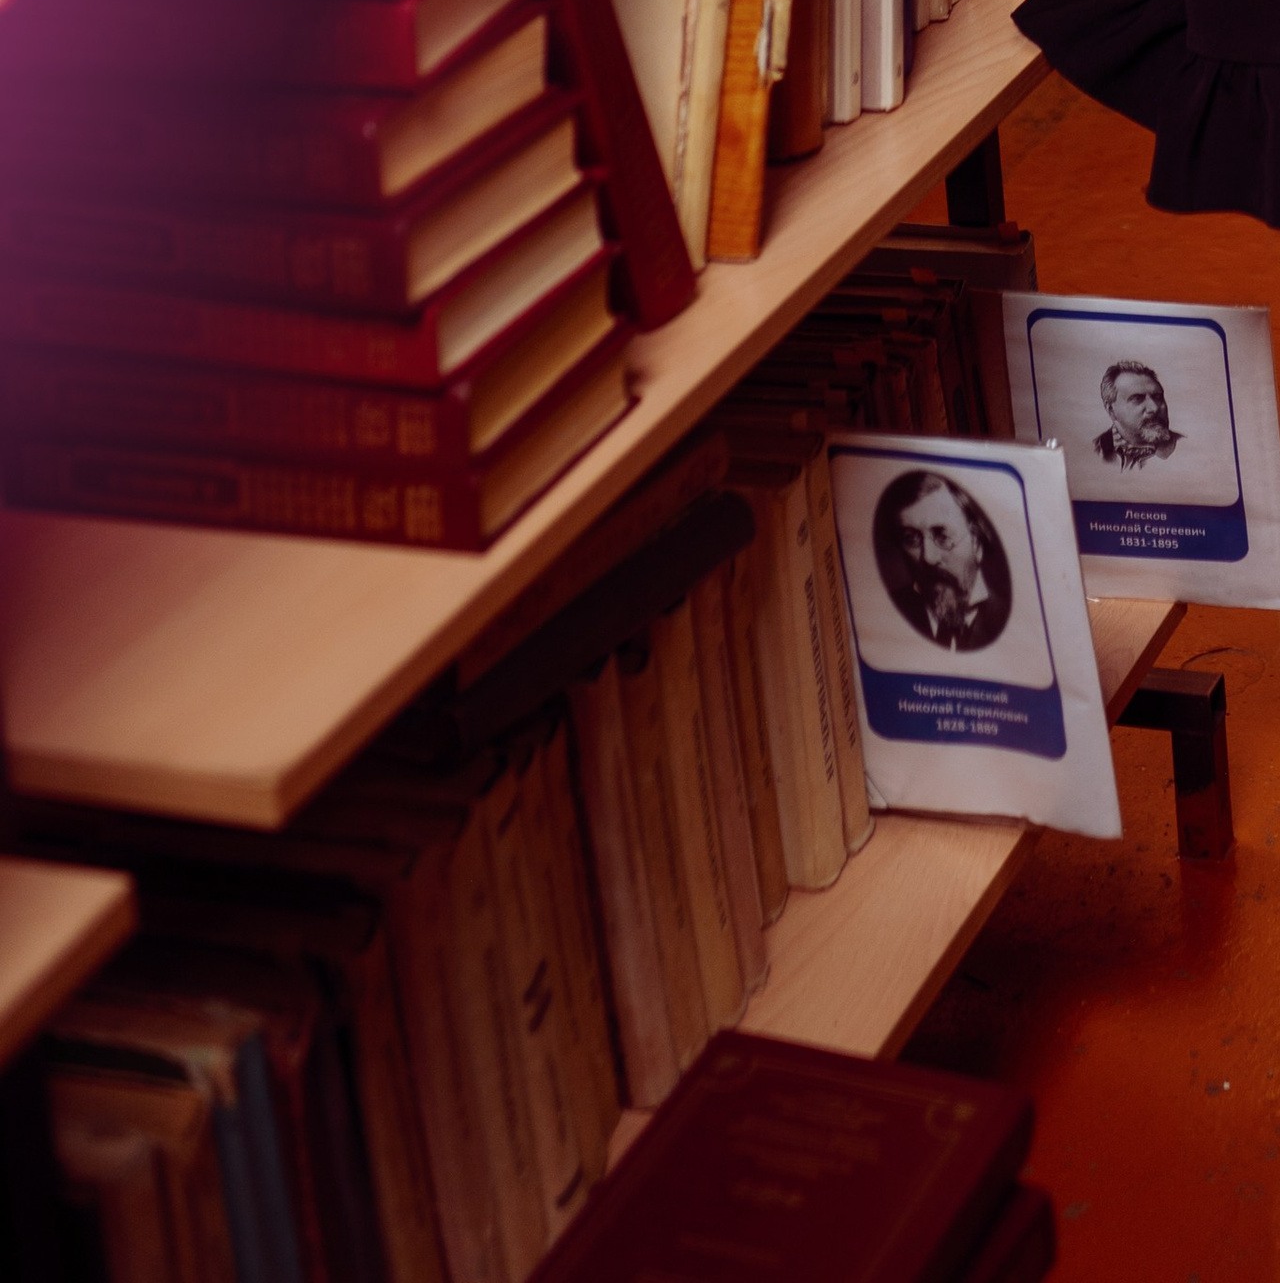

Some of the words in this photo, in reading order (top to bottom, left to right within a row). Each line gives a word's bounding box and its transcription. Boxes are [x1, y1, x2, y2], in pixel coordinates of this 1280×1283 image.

[1125, 509, 1168, 522] Лесков
[1090, 521, 1142, 535] Николай
[1144, 524, 1206, 539] Сергеевич
[1119, 536, 1180, 550] 1831-1895
[913, 682, 1009, 705] Чернышевский
[899, 698, 954, 716] Николай
[956, 701, 1029, 727] Гаврилович
